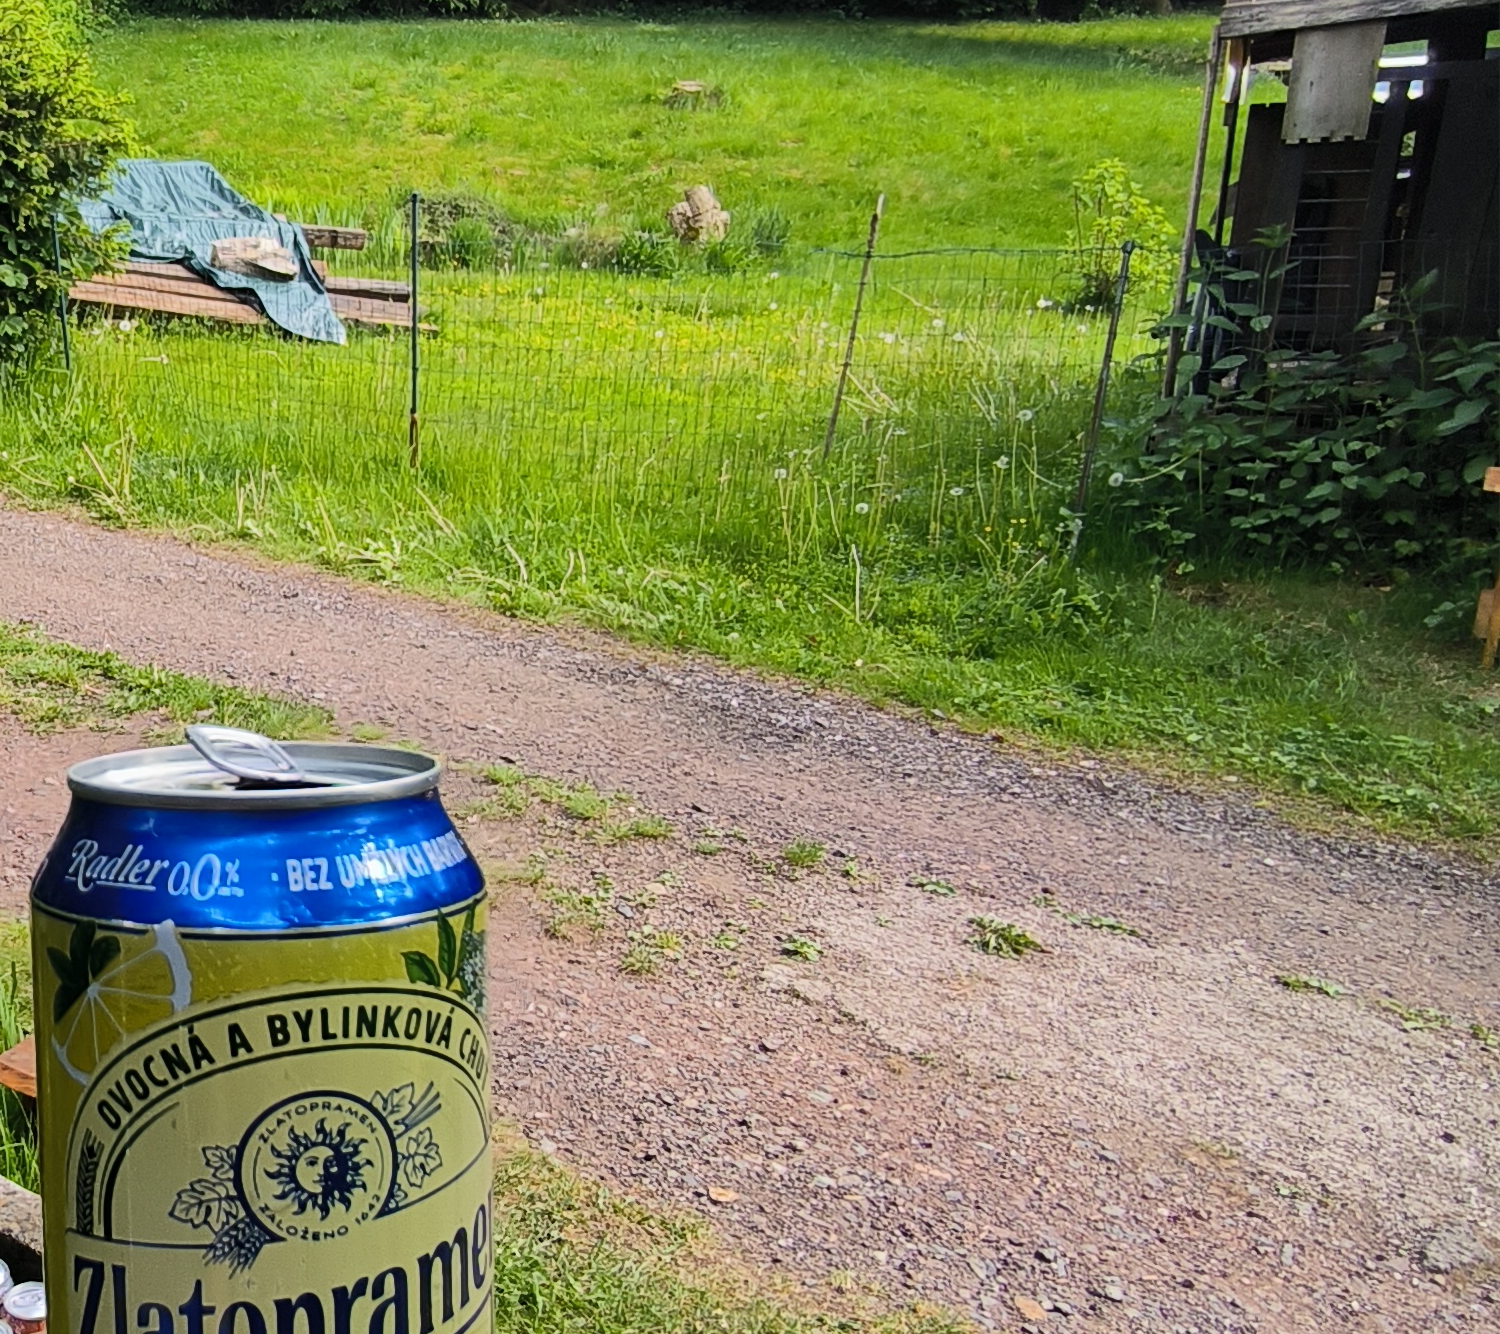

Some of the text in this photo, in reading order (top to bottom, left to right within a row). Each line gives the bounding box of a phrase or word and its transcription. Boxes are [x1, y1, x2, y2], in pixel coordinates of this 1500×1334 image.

[66, 838, 169, 892] Radler
[286, 856, 333, 892] BEZ
[97, 1024, 215, 1130] OVOCNÁ
[227, 1022, 254, 1058] A
[266, 1005, 455, 1049] BYLINKOVÁ
[258, 1101, 377, 1144] ZLATOPRAMEN
[259, 1202, 349, 1242] ZALOŽENO
